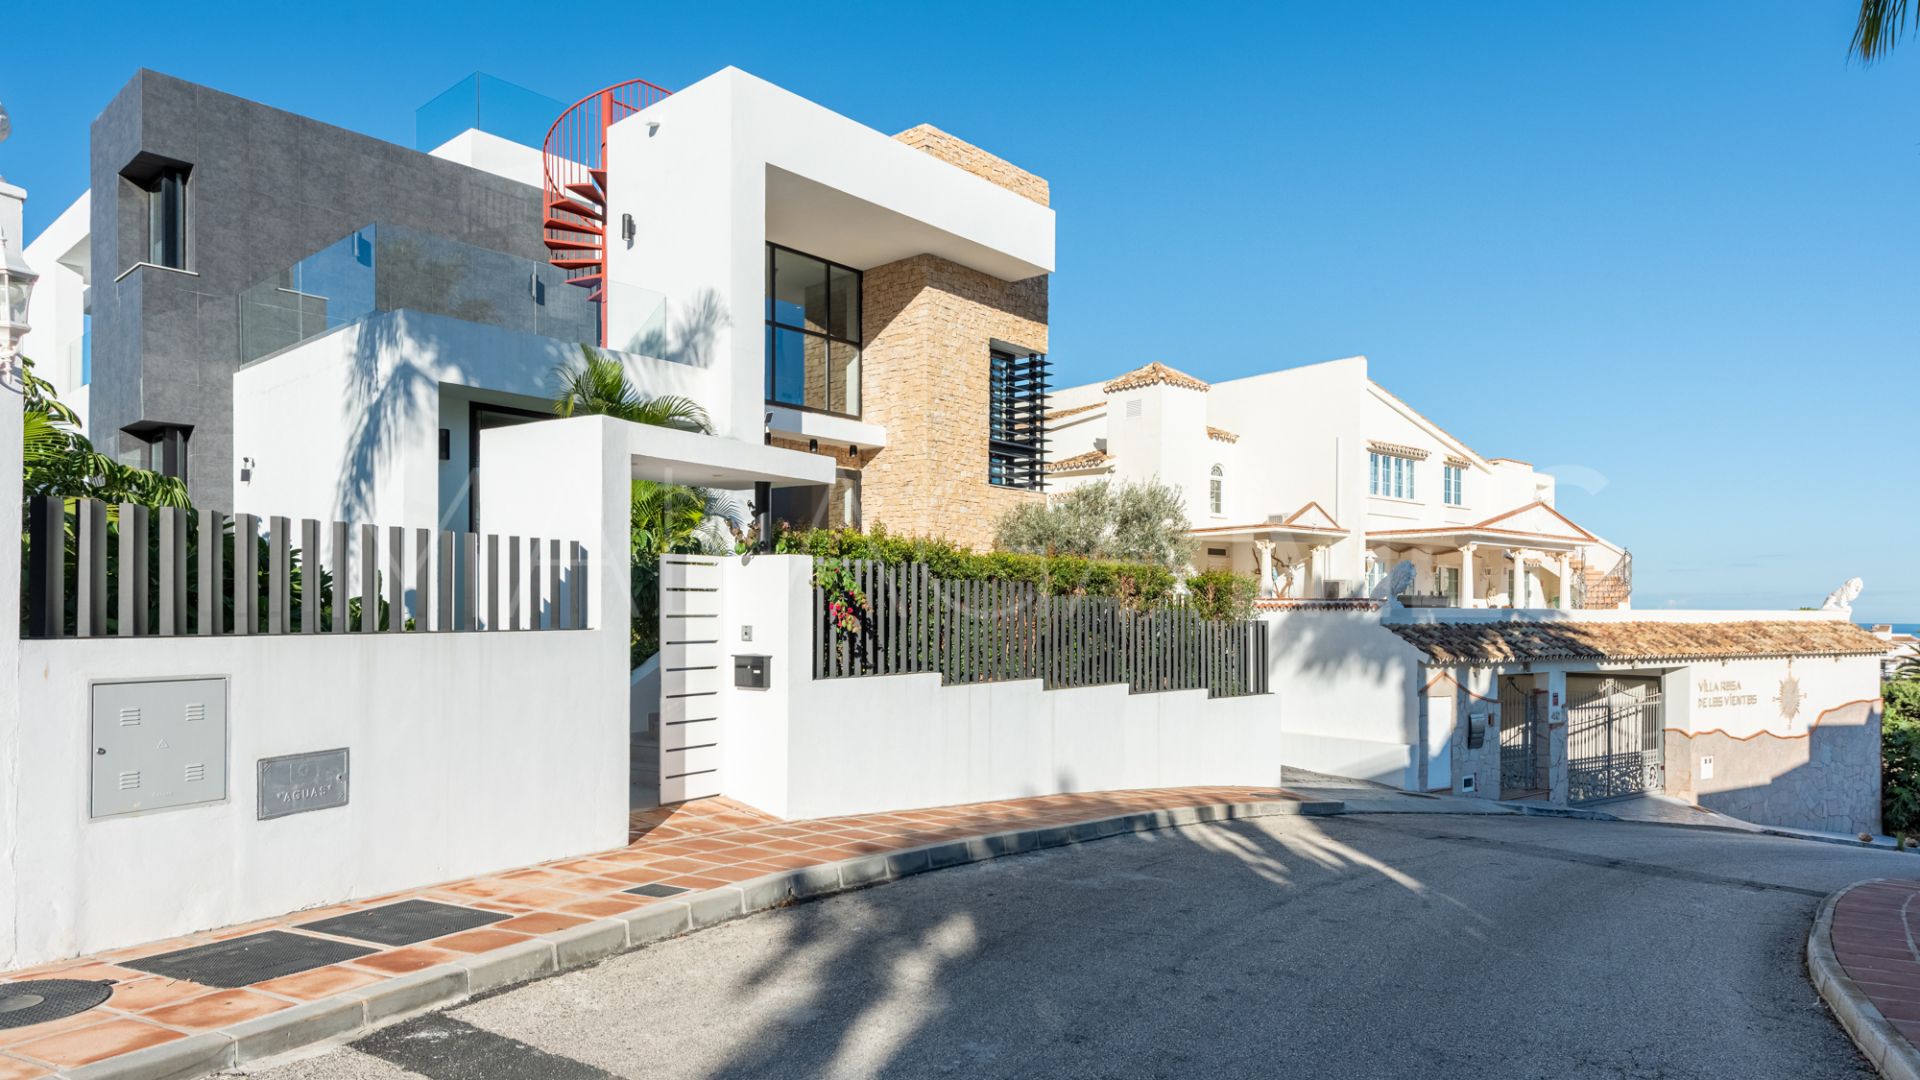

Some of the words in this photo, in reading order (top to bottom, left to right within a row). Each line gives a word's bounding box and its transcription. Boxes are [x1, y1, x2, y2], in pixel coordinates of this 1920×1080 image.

[1697, 680, 1720, 693] VILLA
[1721, 680, 1742, 692] ROSA
[1697, 697, 1708, 709] DE
[1709, 695, 1724, 708] LOS
